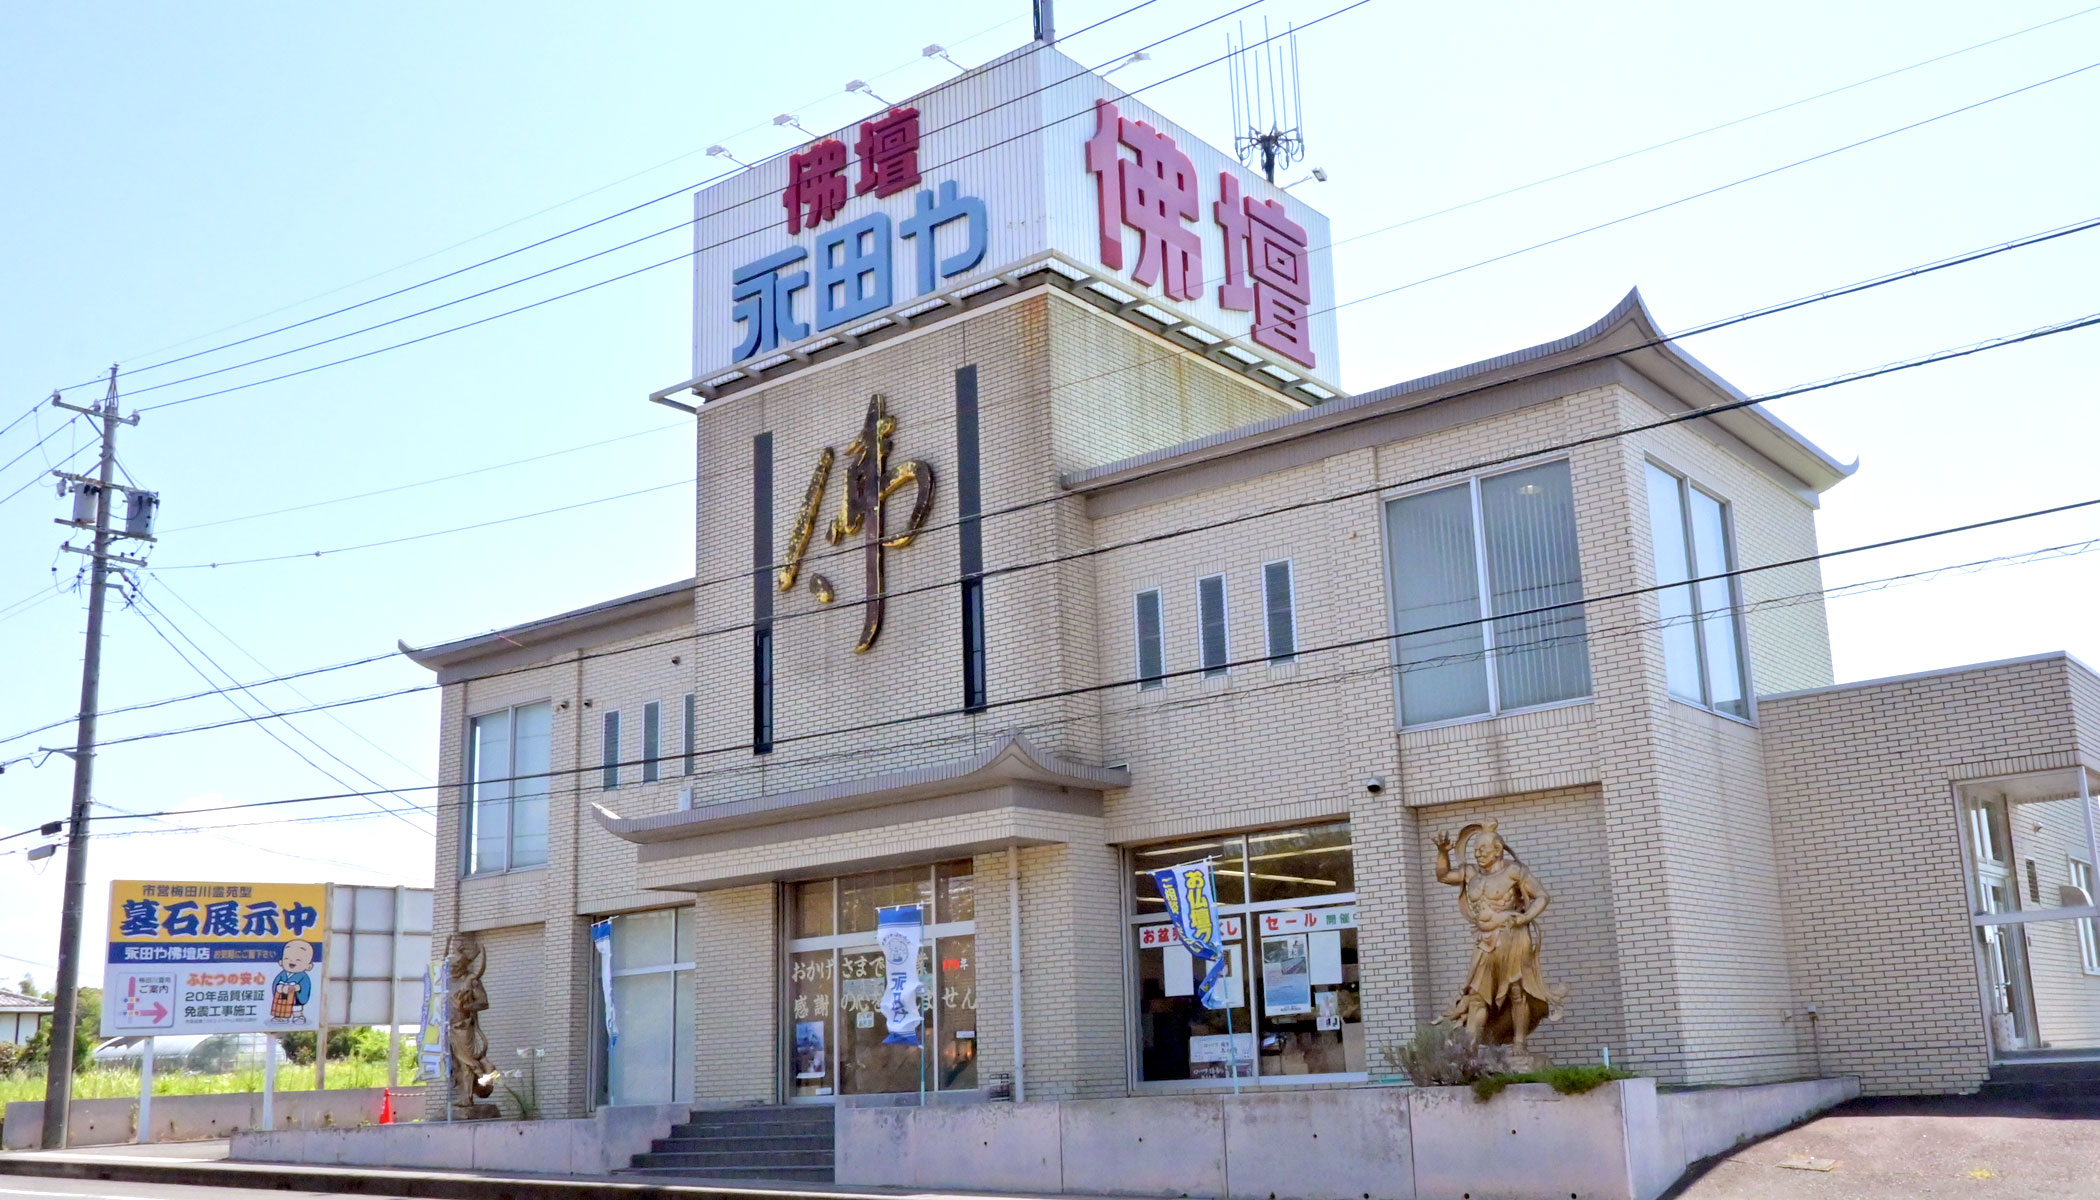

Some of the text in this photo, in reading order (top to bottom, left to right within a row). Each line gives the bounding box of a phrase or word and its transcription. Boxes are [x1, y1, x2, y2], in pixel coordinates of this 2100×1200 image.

[120, 899, 318, 937] 墓石展示中
[1265, 912, 1318, 931] セール
[186, 971, 267, 987] ふたつの安心
[139, 984, 169, 994] ご案内
[185, 990, 265, 1003] 20年品質保証
